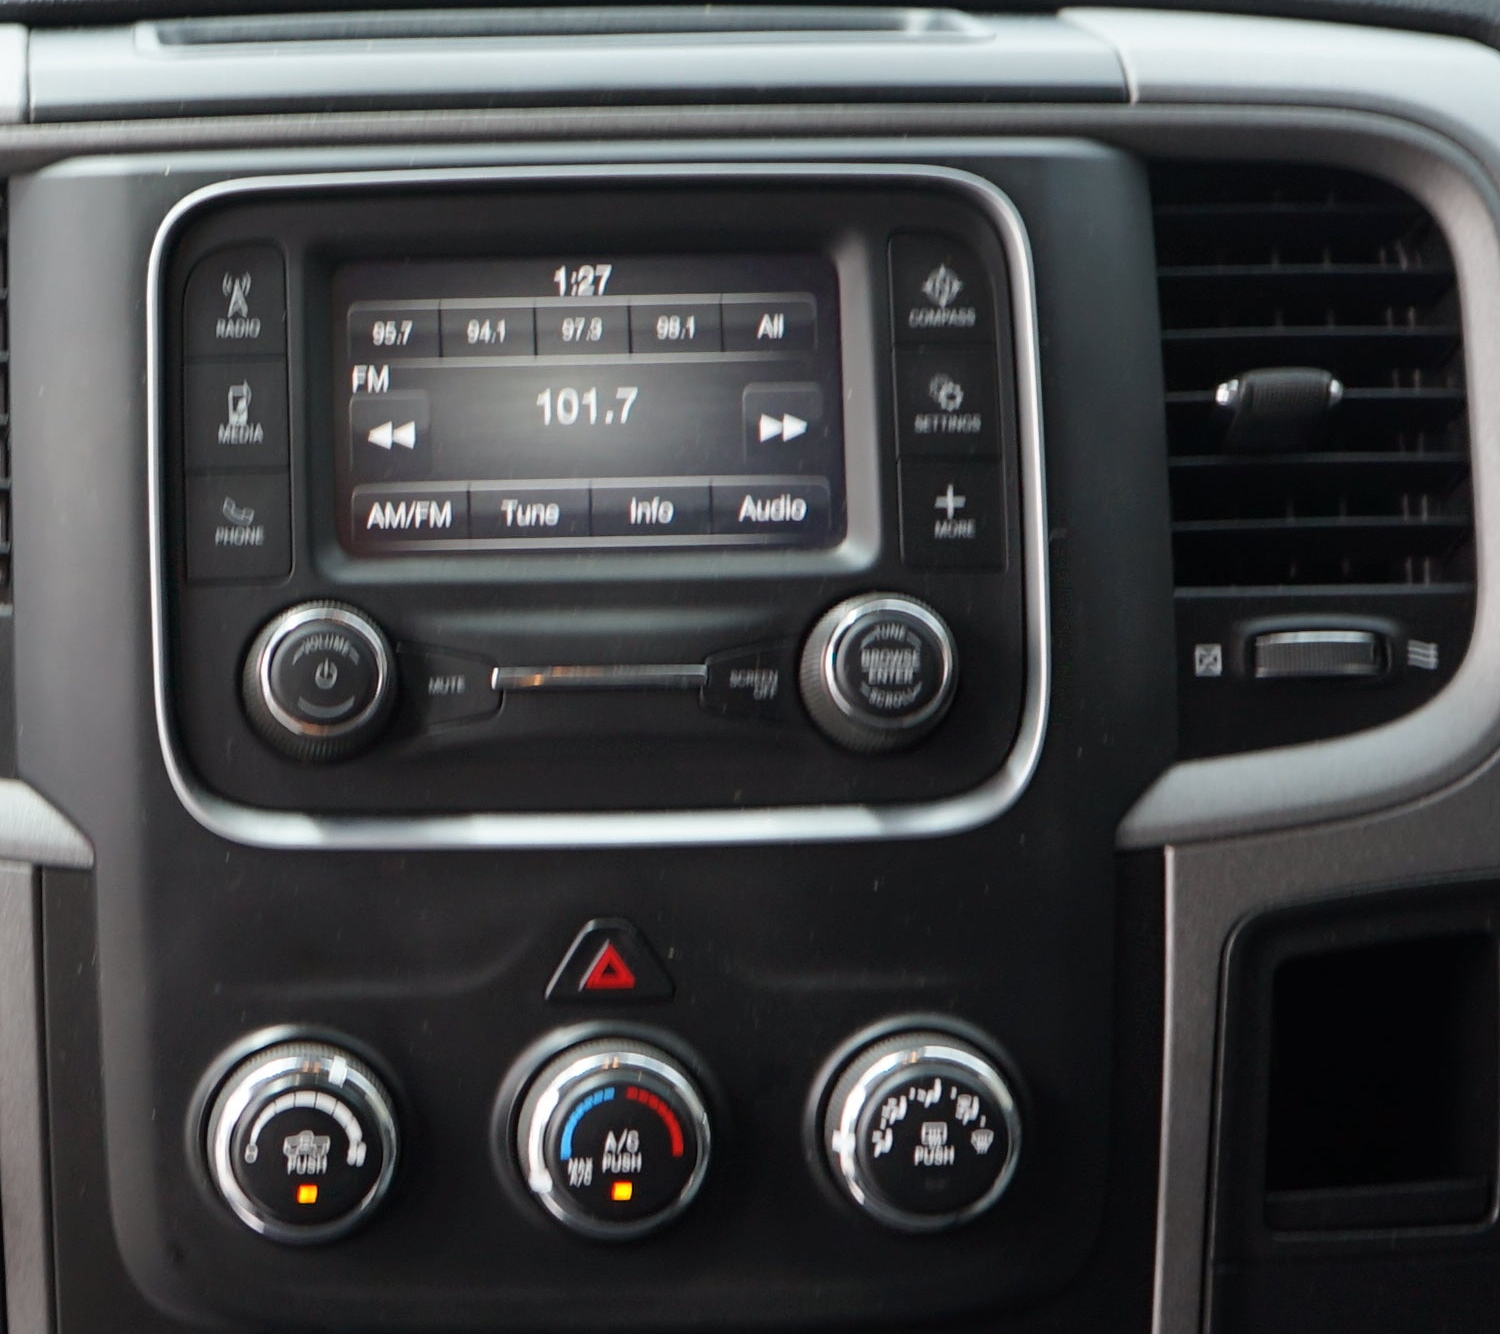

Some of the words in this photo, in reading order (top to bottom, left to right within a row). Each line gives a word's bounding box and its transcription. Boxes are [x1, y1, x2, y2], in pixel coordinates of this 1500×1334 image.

[554, 264, 612, 296] 1:27
[216, 318, 261, 338] RADIO
[757, 313, 784, 340] All
[908, 307, 976, 327] COMPASS
[372, 321, 413, 345] 95.7
[467, 318, 505, 344] 94.1
[352, 364, 390, 393] FM
[536, 387, 638, 425] 101.7
[218, 423, 264, 444] MEDIA
[914, 414, 981, 433] SETTINGS
[366, 501, 452, 529] AM/FM
[501, 499, 560, 527] Tune
[630, 496, 675, 525] Info
[738, 494, 806, 523] Audio
[215, 526, 264, 546] PHONE
[935, 519, 975, 539] MORE
[875, 623, 906, 642] TUNE
[301, 634, 351, 655] VOLUME
[861, 648, 920, 670] BROWSE
[428, 675, 465, 695] MUTE
[730, 669, 778, 688] SCREEN
[868, 667, 914, 685] ENTER
[605, 1128, 640, 1154] A/C
[287, 1154, 328, 1175] PUSH
[602, 1151, 642, 1173] PUSH
[914, 1144, 955, 1166] PUSH
